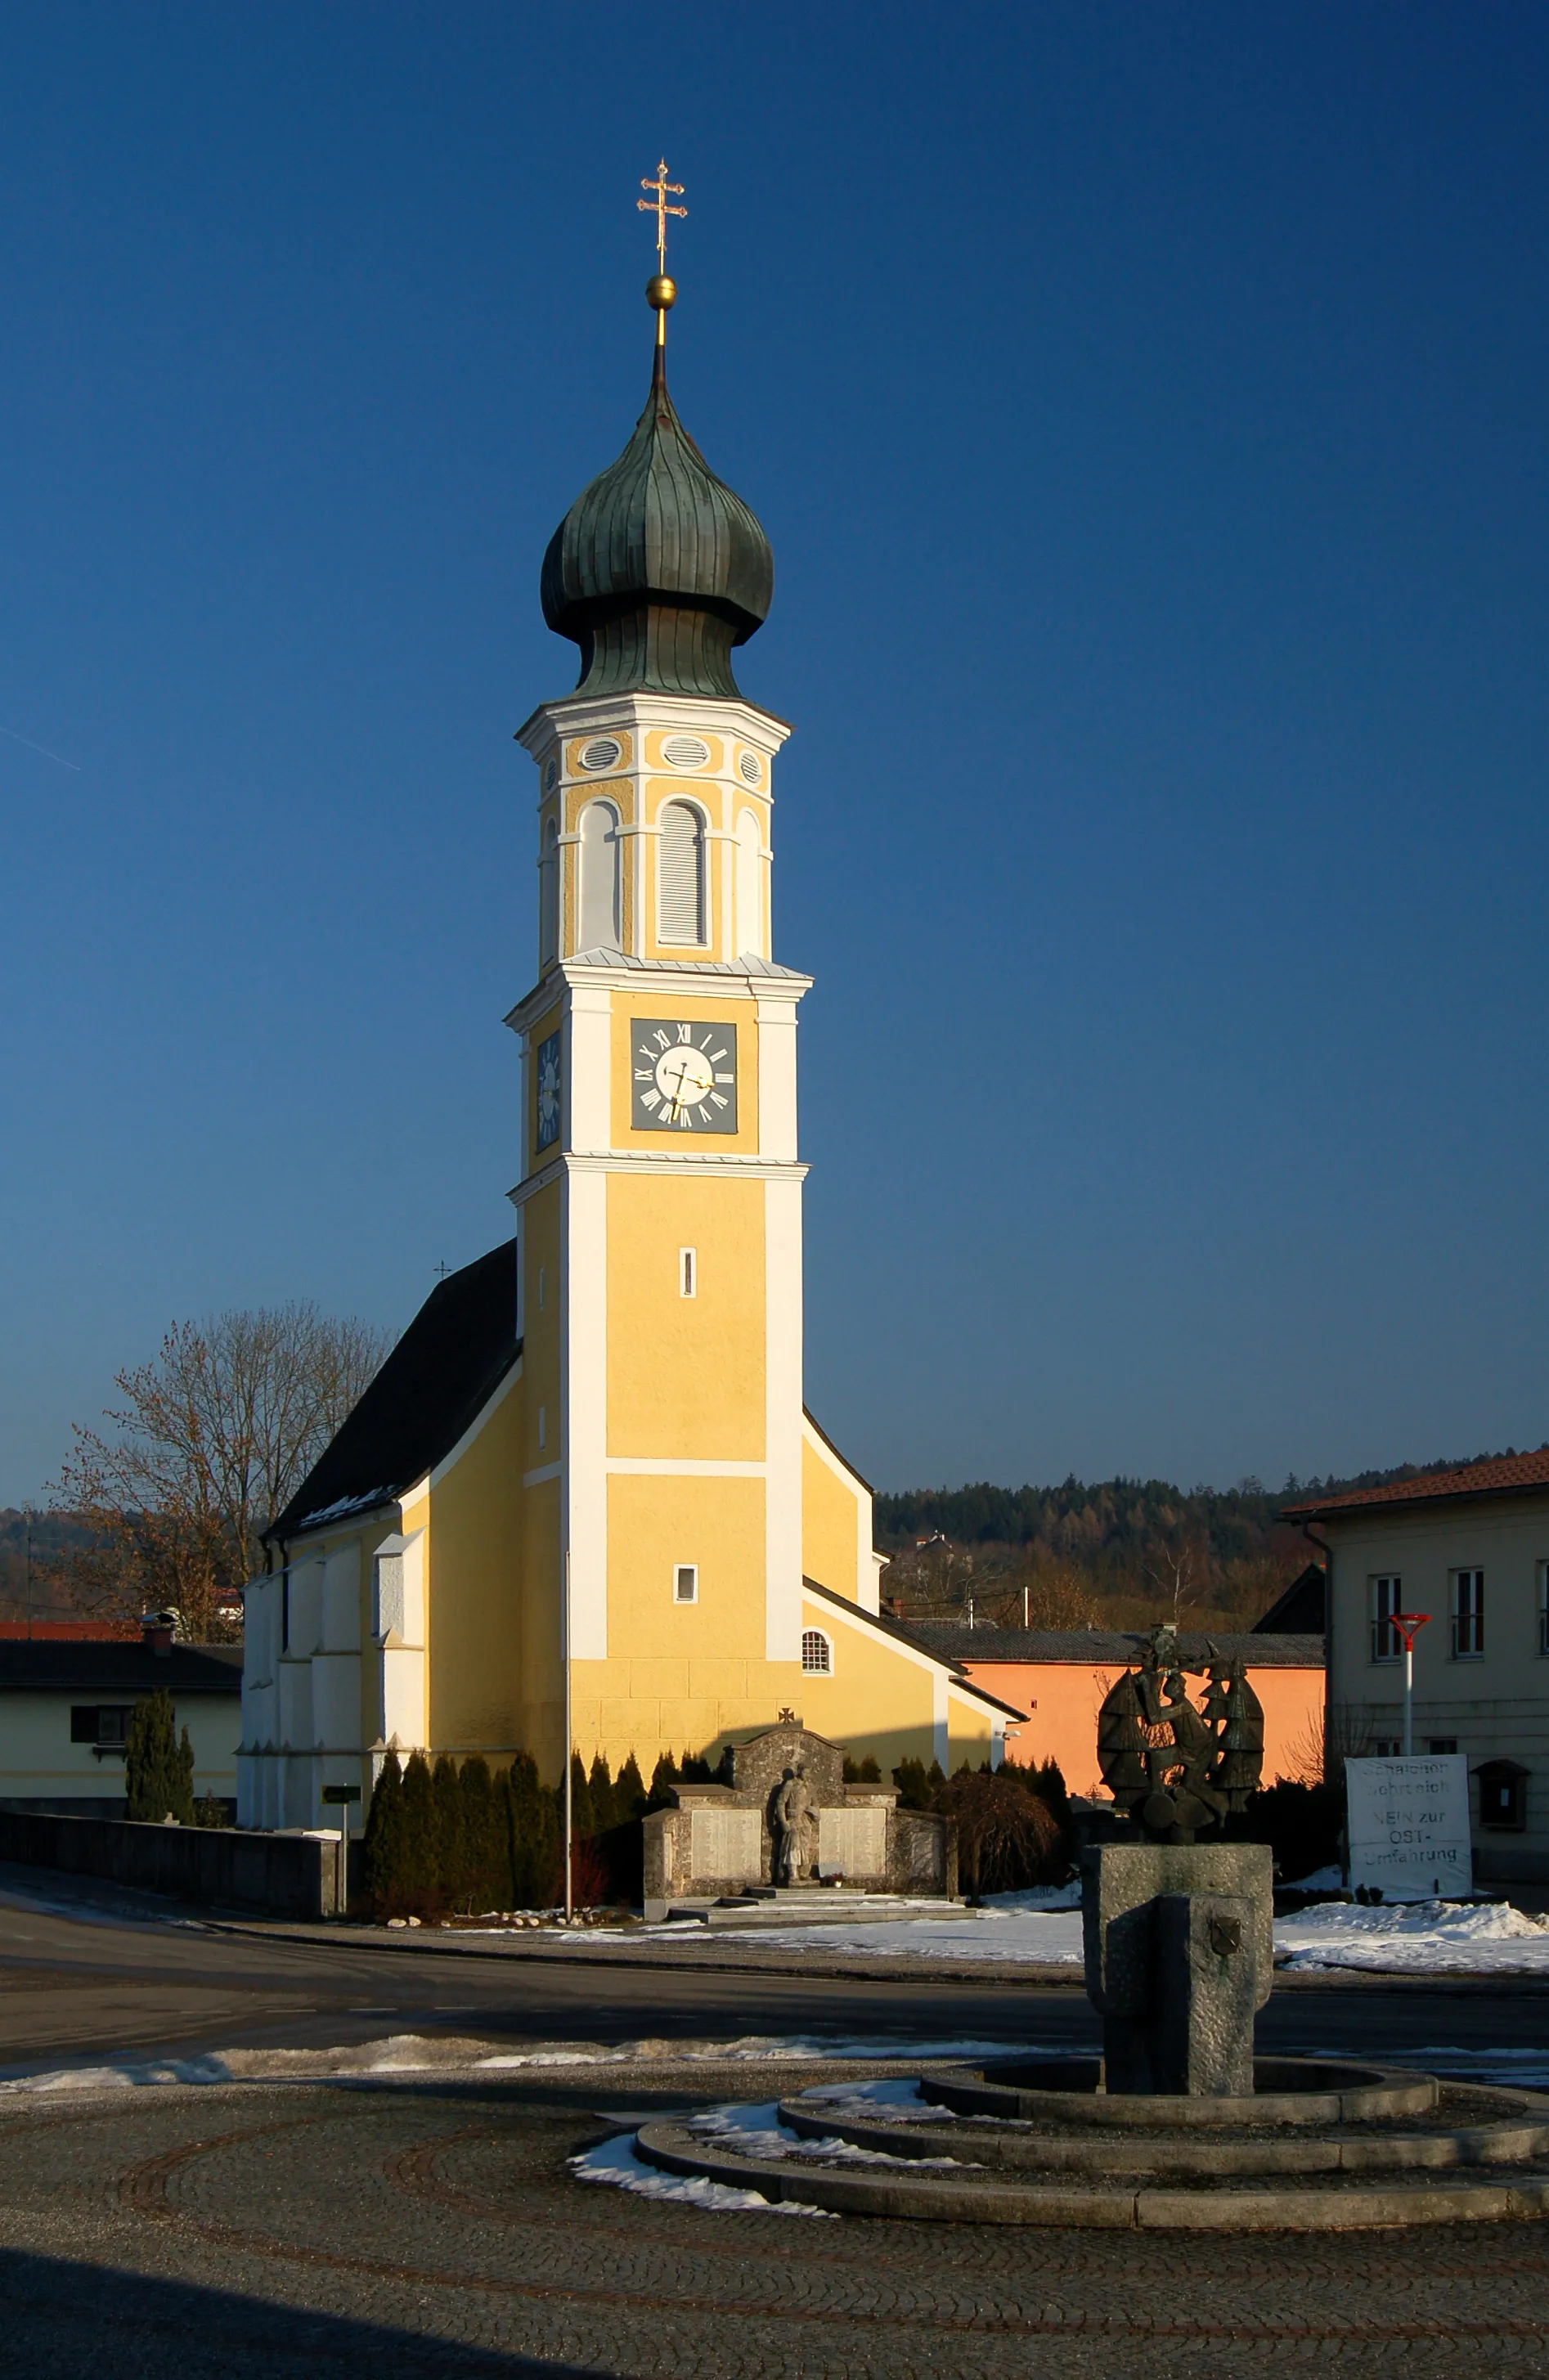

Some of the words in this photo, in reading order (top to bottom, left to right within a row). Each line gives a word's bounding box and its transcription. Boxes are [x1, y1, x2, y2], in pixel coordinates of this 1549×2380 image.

[653, 1029, 671, 1051] XI
[676, 1023, 691, 1044] XII
[639, 1044, 658, 1062] X
[1416, 1780, 1449, 1794] sich
[1418, 1812, 1446, 1823] zur
[1389, 1830, 1431, 1844] OST-
[1364, 1848, 1457, 1866] Umfahrung
